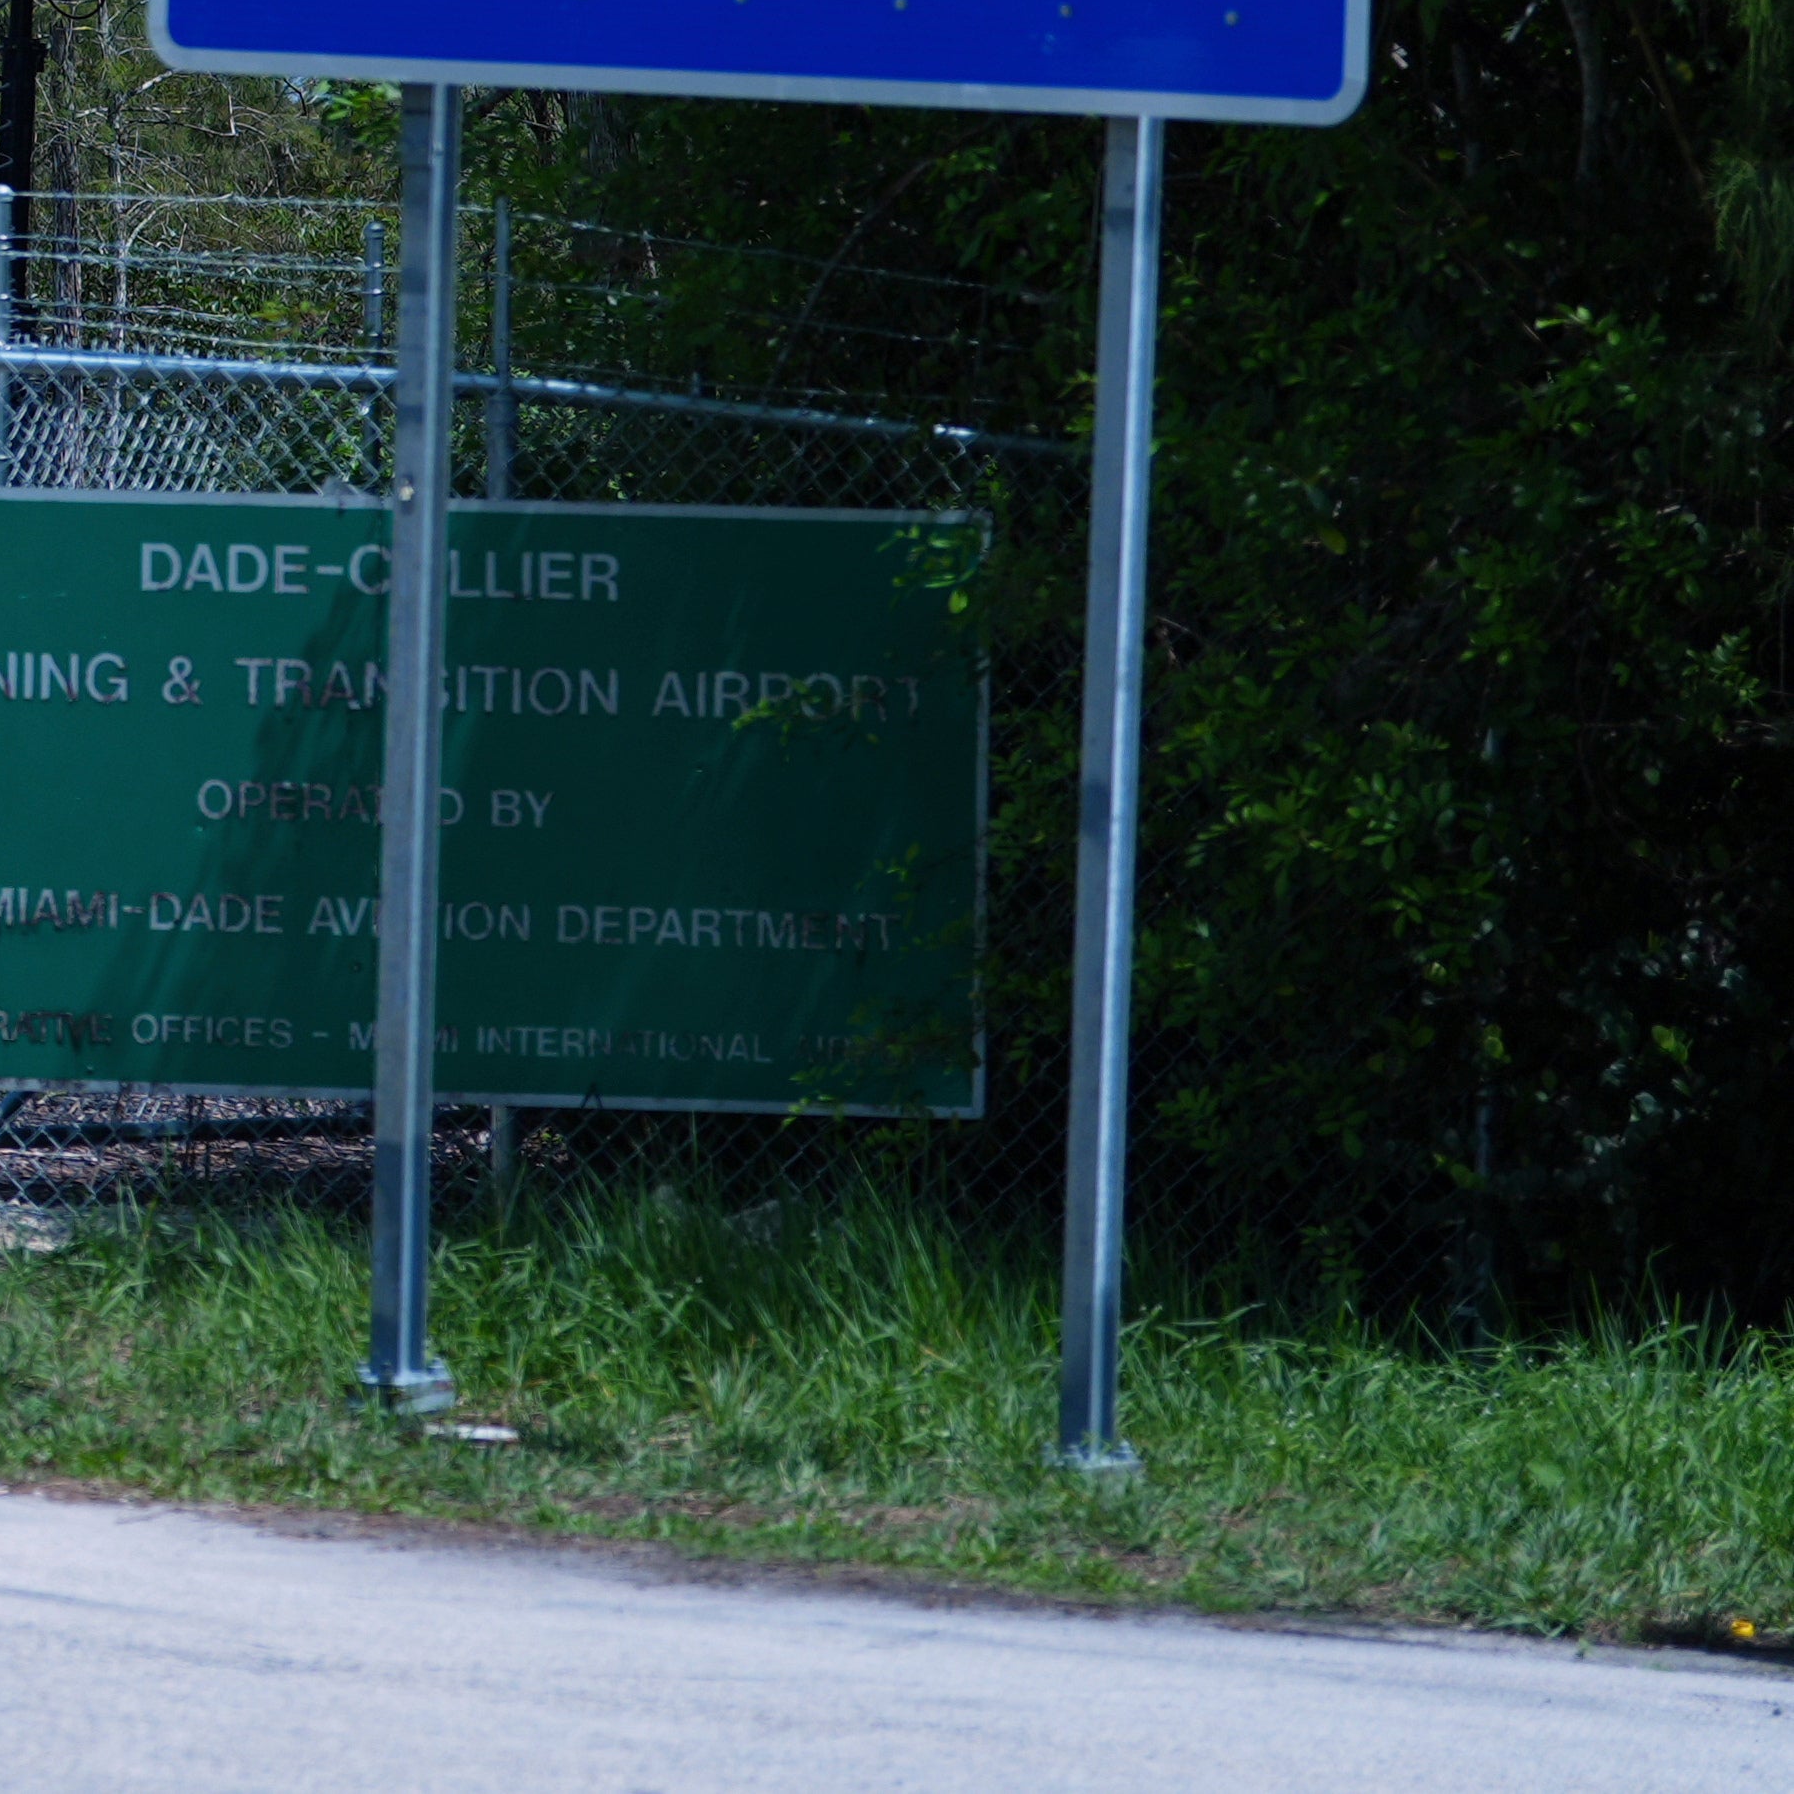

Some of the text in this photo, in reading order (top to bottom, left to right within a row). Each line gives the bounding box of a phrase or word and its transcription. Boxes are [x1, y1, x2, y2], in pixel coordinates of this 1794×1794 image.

[139, 541, 621, 602] DADE-CLLIER
[160, 654, 204, 705] &
[233, 656, 621, 717] TRANITION
[489, 788, 556, 828] BY
[555, 905, 905, 952] DEPARTMENT
[130, 1012, 294, 1050] OFFICES
[474, 1024, 775, 1064] INTERNATIONAL
